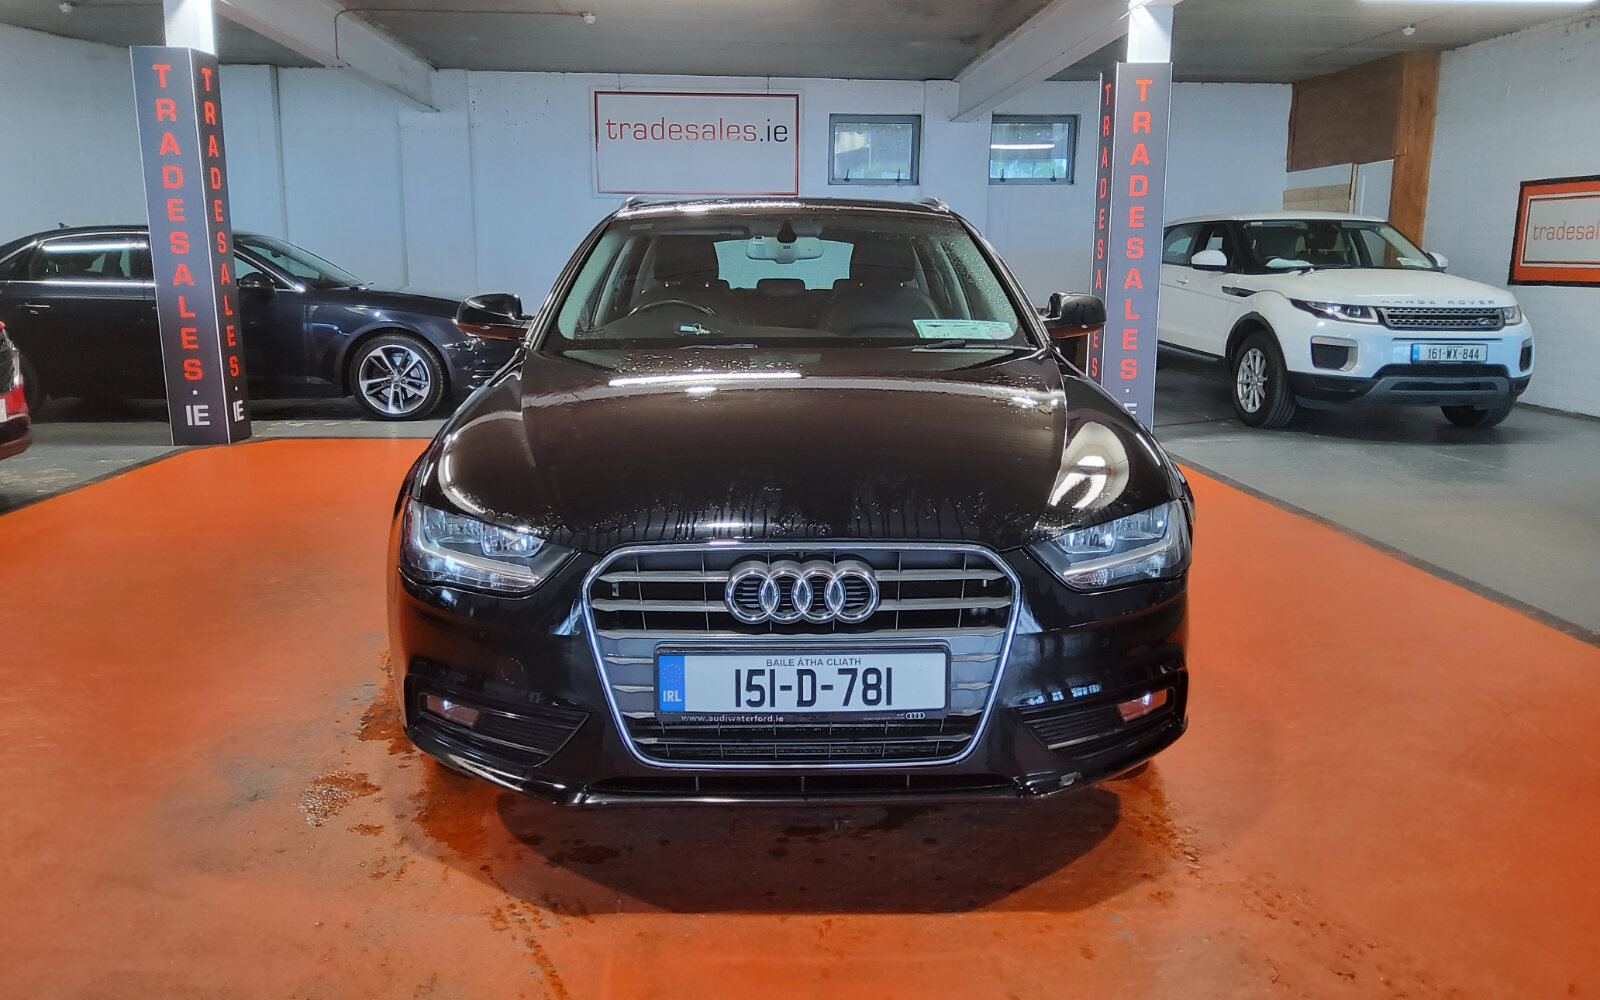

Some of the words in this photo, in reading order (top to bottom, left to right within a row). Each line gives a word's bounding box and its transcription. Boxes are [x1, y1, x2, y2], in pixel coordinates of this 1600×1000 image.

[605, 117, 788, 142] tradesales.ie
[1091, 83, 1111, 378] TRADESAES
[1427, 347, 1480, 360] 161-WX-844
[766, 658, 795, 667] BAILE
[826, 657, 862, 666] CLIATH
[735, 667, 893, 708] 151-D-781
[663, 690, 682, 703] IRL
[681, 714, 784, 723] www.audiwaterford.ie
